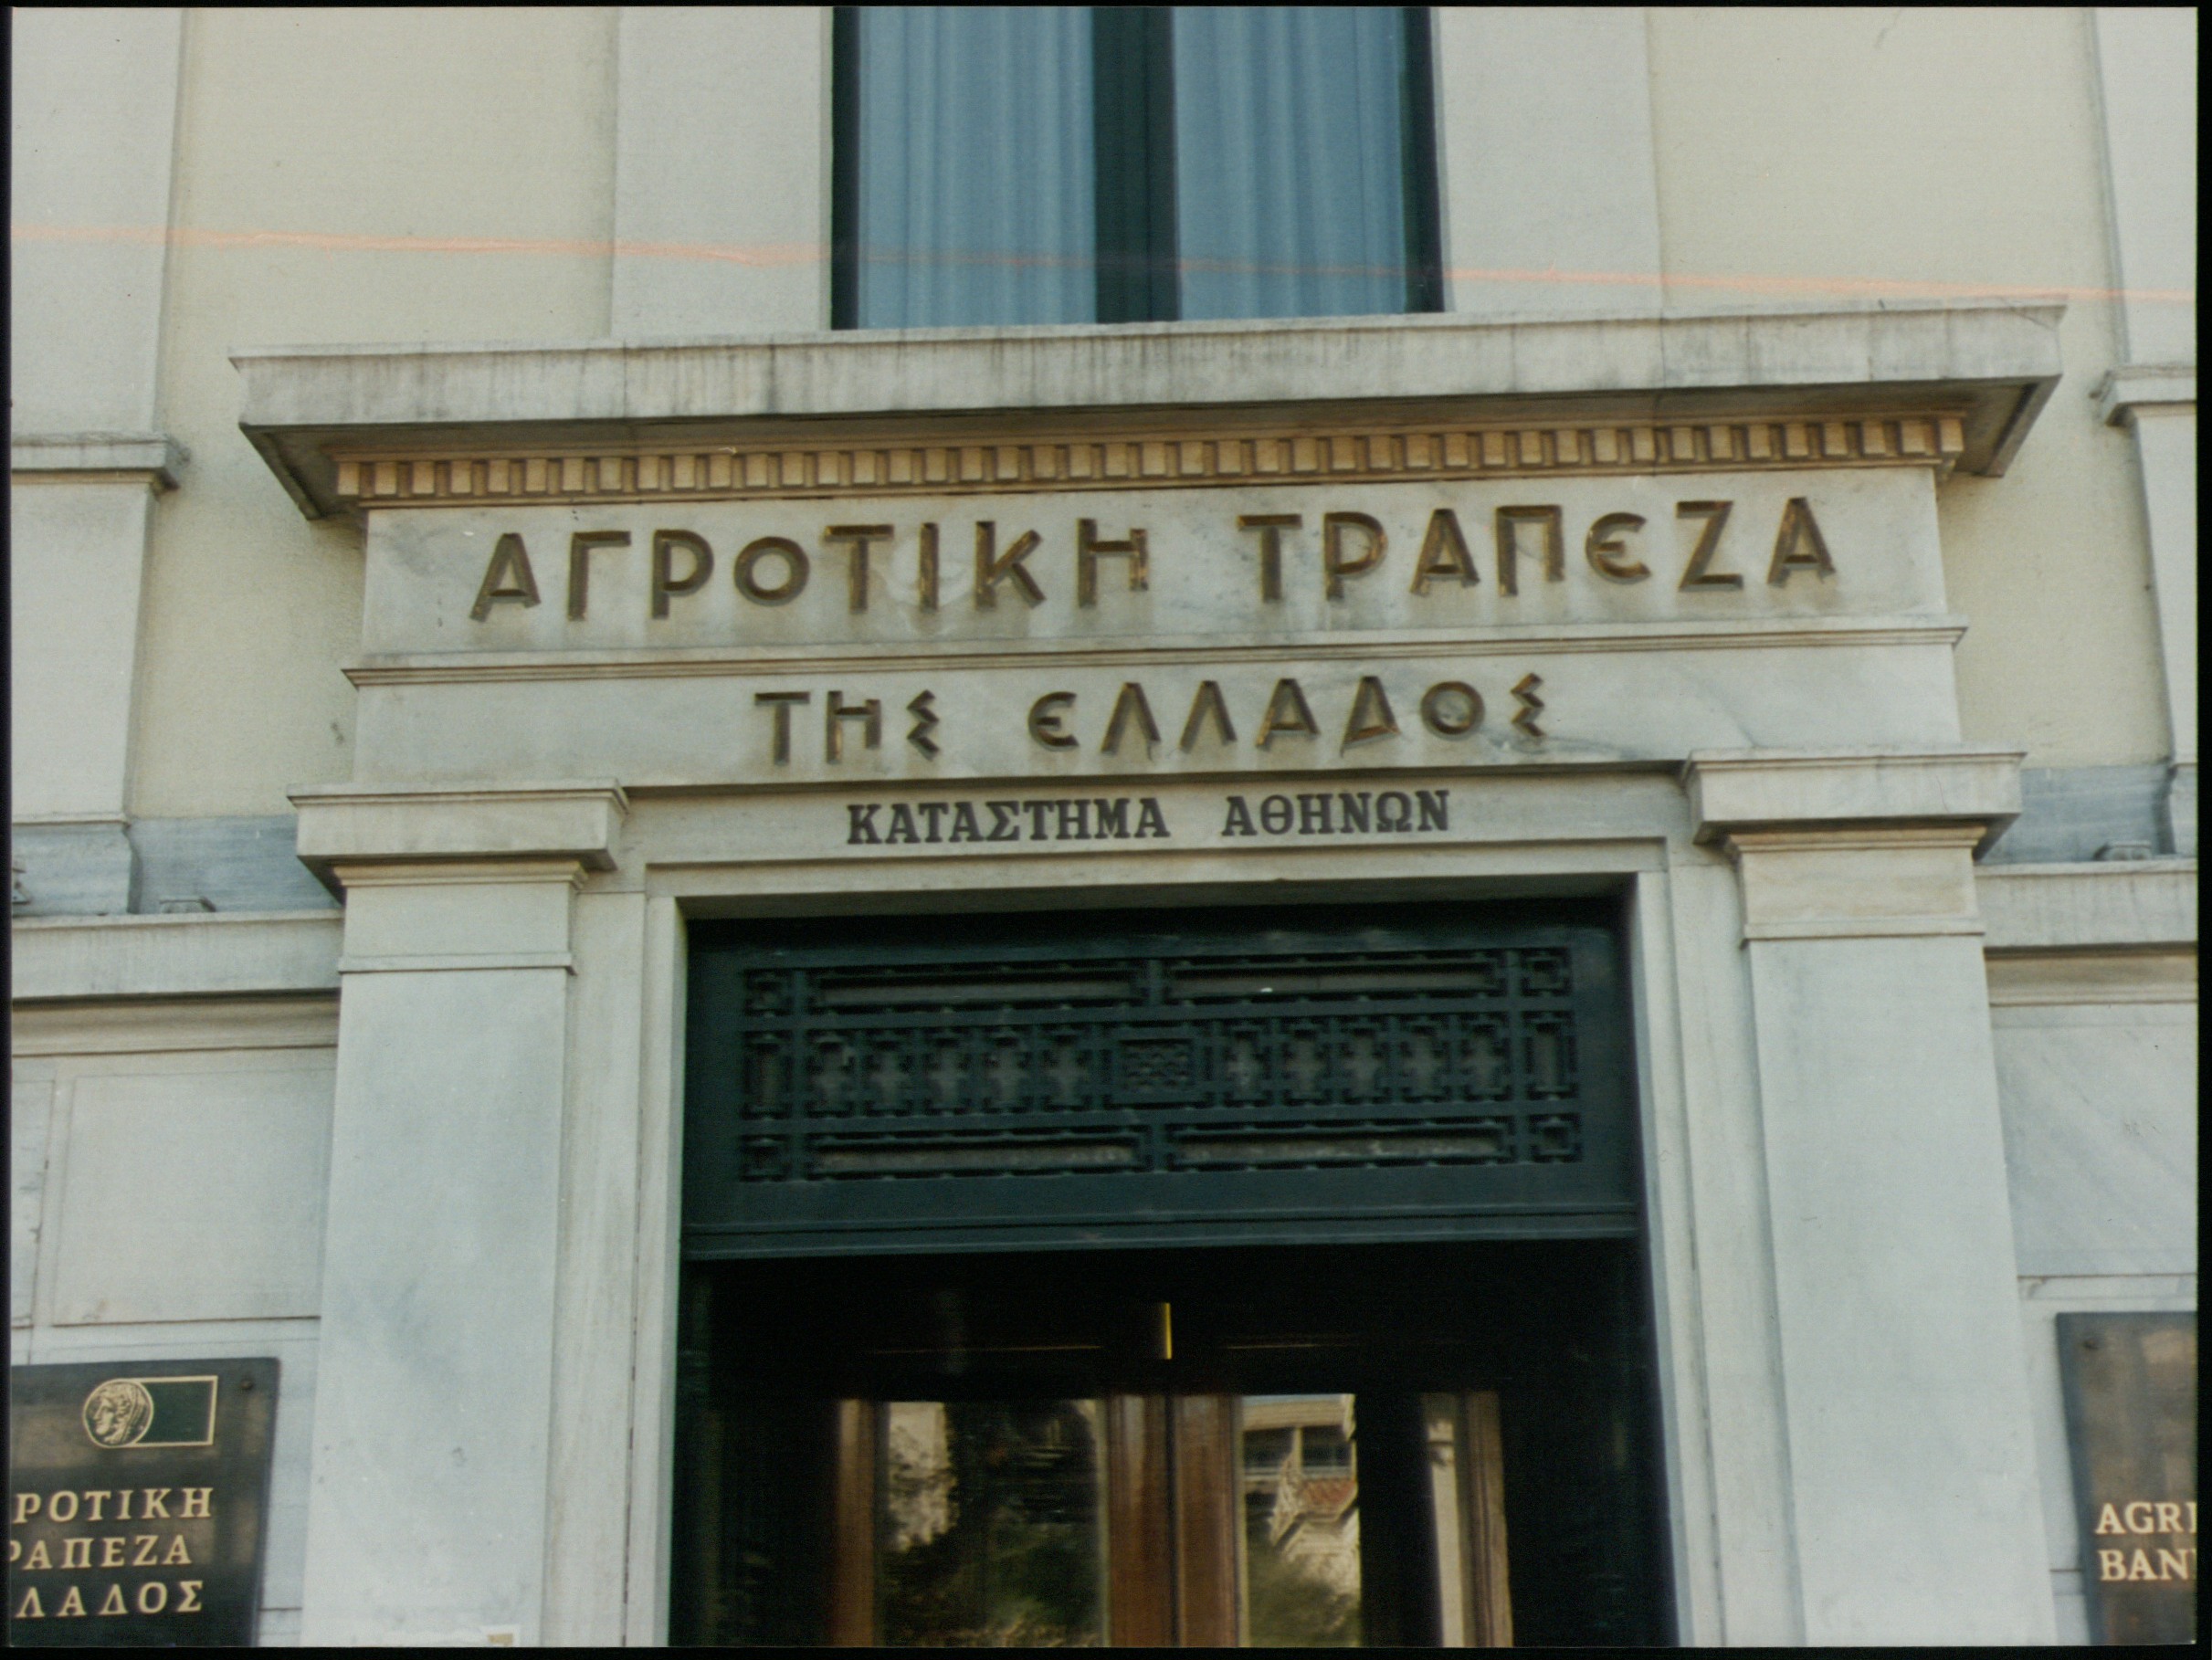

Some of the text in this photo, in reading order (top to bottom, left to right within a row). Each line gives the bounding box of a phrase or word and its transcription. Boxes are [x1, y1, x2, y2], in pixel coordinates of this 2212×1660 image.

[469, 495, 1837, 622] ΑΓΡΟΤΙΚΗ ΤΡΑΠΕΖΑ
[753, 671, 1547, 765] ΤΗΣ ΕΛΛΑΔΟΣ
[846, 788, 1450, 846] ΚΑΤΑΣΤΗΜΑ ΑΘΗΝΩΝ
[12, 1487, 214, 1524] ΡΟΤΙΚΗ
[2099, 1549, 2196, 1581] BAN
[15, 1580, 204, 1619] ΛΑΔΟΣ
